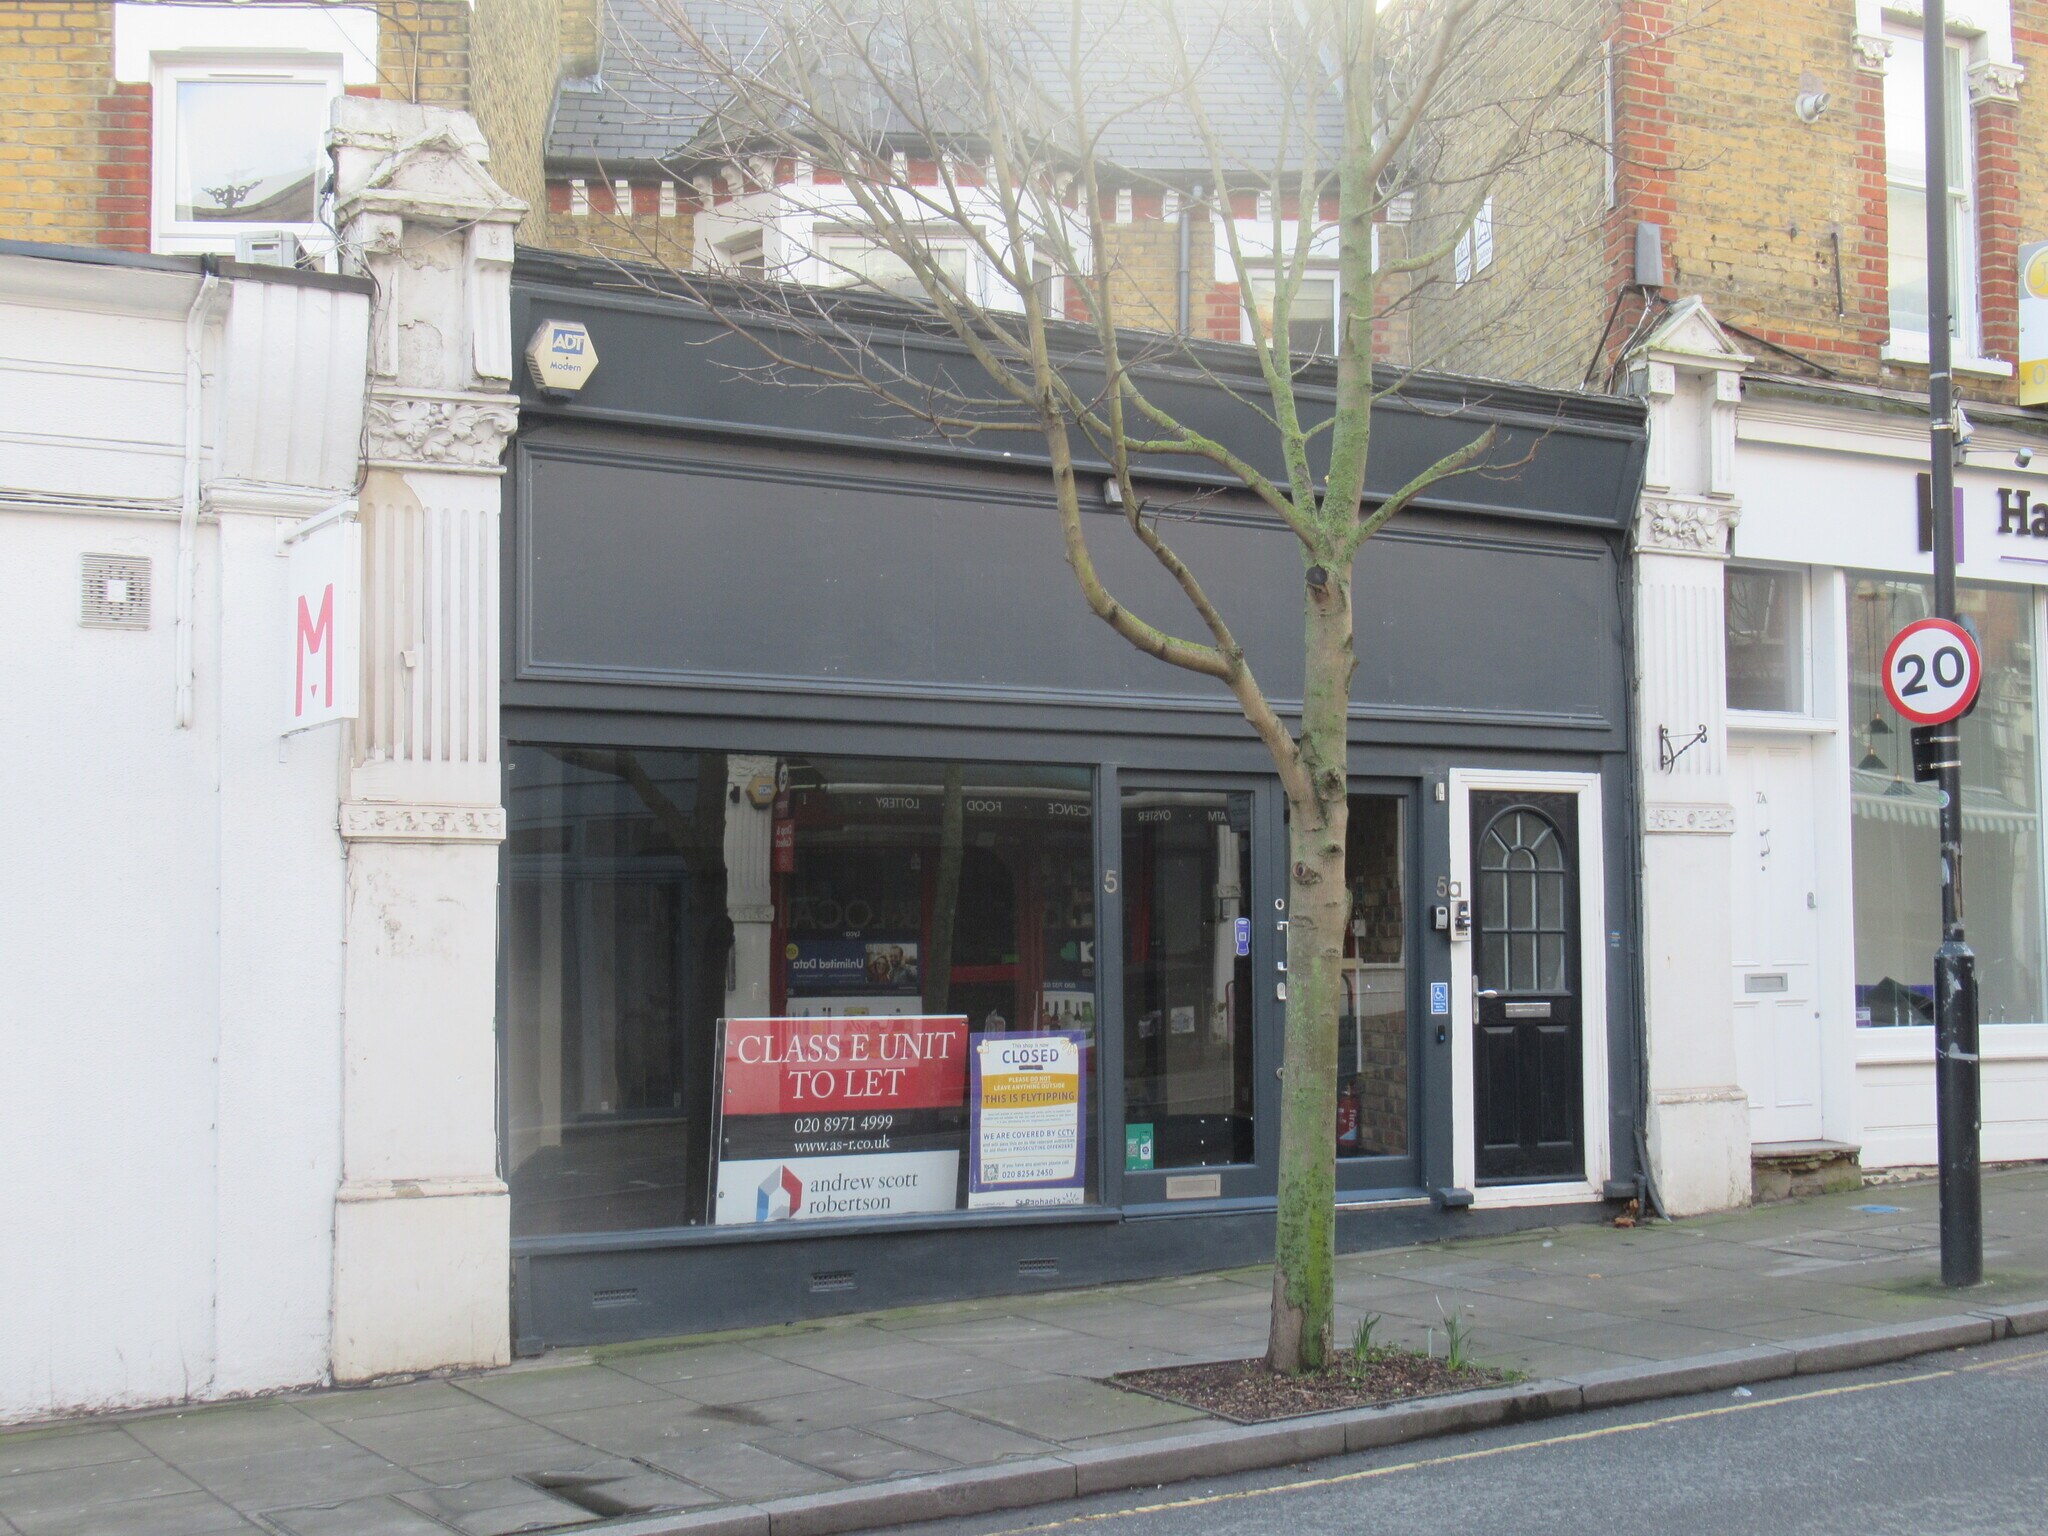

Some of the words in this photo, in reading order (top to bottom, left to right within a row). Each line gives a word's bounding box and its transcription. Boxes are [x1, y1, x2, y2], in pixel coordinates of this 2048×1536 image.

[552, 333, 585, 351] ADT
[550, 361, 582, 372] Modern
[1897, 645, 1965, 698] 20
[1756, 791, 1767, 804] 7A
[1103, 869, 1118, 894] 5
[1436, 875, 1462, 898] 5a
[738, 1034, 840, 1064] CLASS
[849, 1034, 870, 1061] E
[879, 1032, 956, 1061] UNIT
[1002, 1049, 1059, 1063] CLOSED
[788, 1070, 835, 1099] TO
[843, 1068, 906, 1098] LET
[984, 1095, 1006, 1103] THIS
[1009, 1094, 1018, 1102] IS
[1021, 1091, 1075, 1102] FLYTIPPING
[794, 1118, 819, 1133] 020
[824, 1116, 855, 1132] 8971
[860, 1115, 893, 1131] 4999
[794, 1135, 890, 1152] www.as-r.co.uk
[984, 1132, 994, 1140] WE
[996, 1131, 1010, 1139] ARE
[1012, 1130, 1045, 1139] COVERED
[810, 1173, 873, 1193] andrew
[878, 1173, 919, 1189] scott
[1002, 1171, 1015, 1179] 020
[1017, 1170, 1034, 1178] 8254
[1036, 1169, 1054, 1177] 2450
[809, 1195, 891, 1214] robertson
